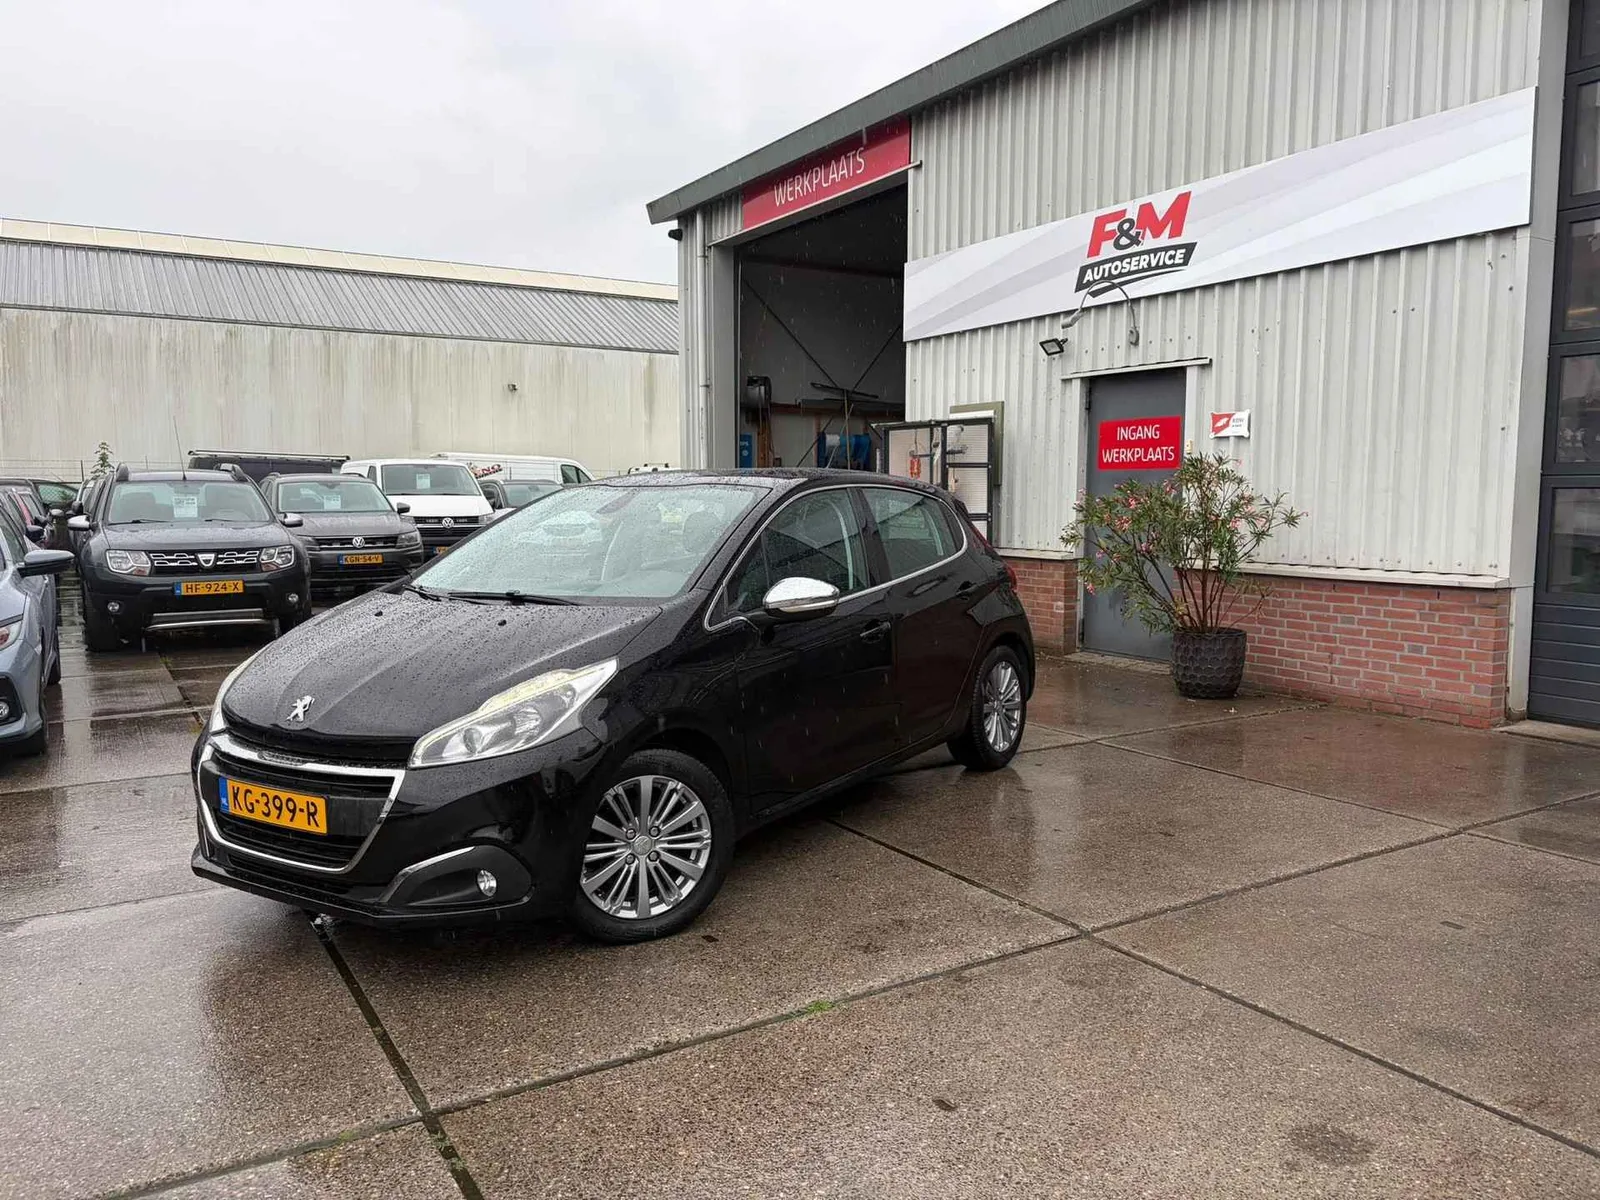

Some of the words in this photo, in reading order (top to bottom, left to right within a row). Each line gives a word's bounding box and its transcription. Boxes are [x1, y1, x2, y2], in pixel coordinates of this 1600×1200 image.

[773, 147, 865, 207] WERKPLAATS
[1087, 191, 1191, 258] F&M
[1083, 249, 1186, 284] AUTOSERVICE
[1116, 424, 1160, 441] INGANG
[1102, 446, 1175, 463] WERKPLAATS
[185, 582, 240, 593] HF-924-X
[232, 786, 319, 827] KG-399-R
